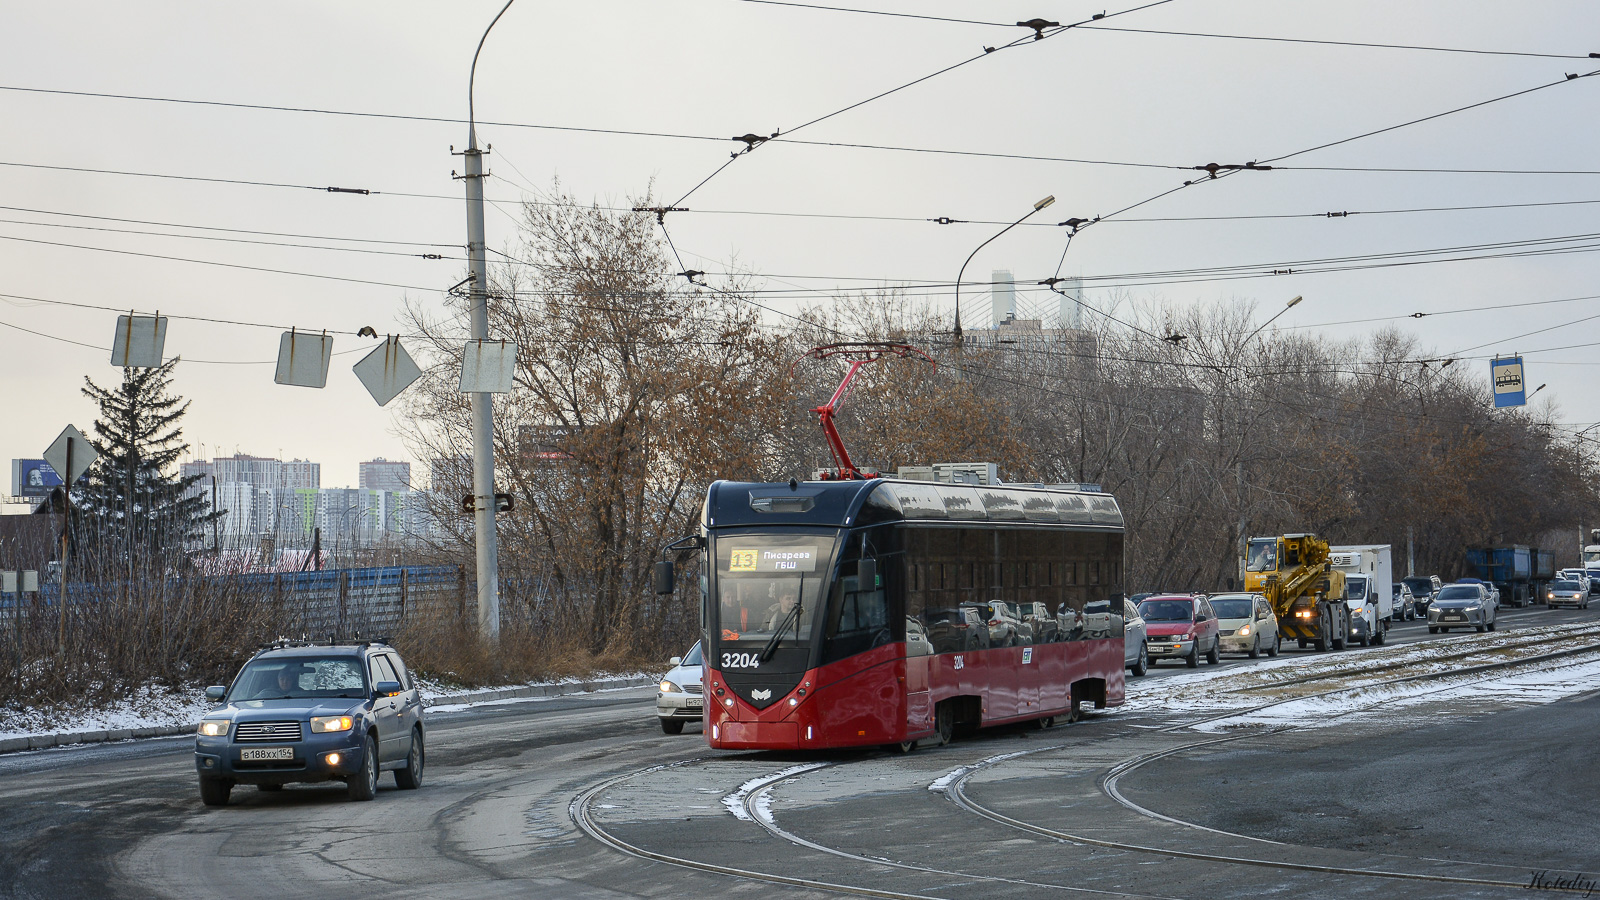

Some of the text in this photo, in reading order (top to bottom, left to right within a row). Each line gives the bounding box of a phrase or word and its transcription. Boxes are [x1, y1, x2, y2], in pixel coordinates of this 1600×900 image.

[731, 553, 754, 567] 13
[763, 551, 810, 560] Писарева
[775, 561, 797, 569] ГБШ
[721, 652, 759, 668] 3204
[953, 655, 964, 669] 3204
